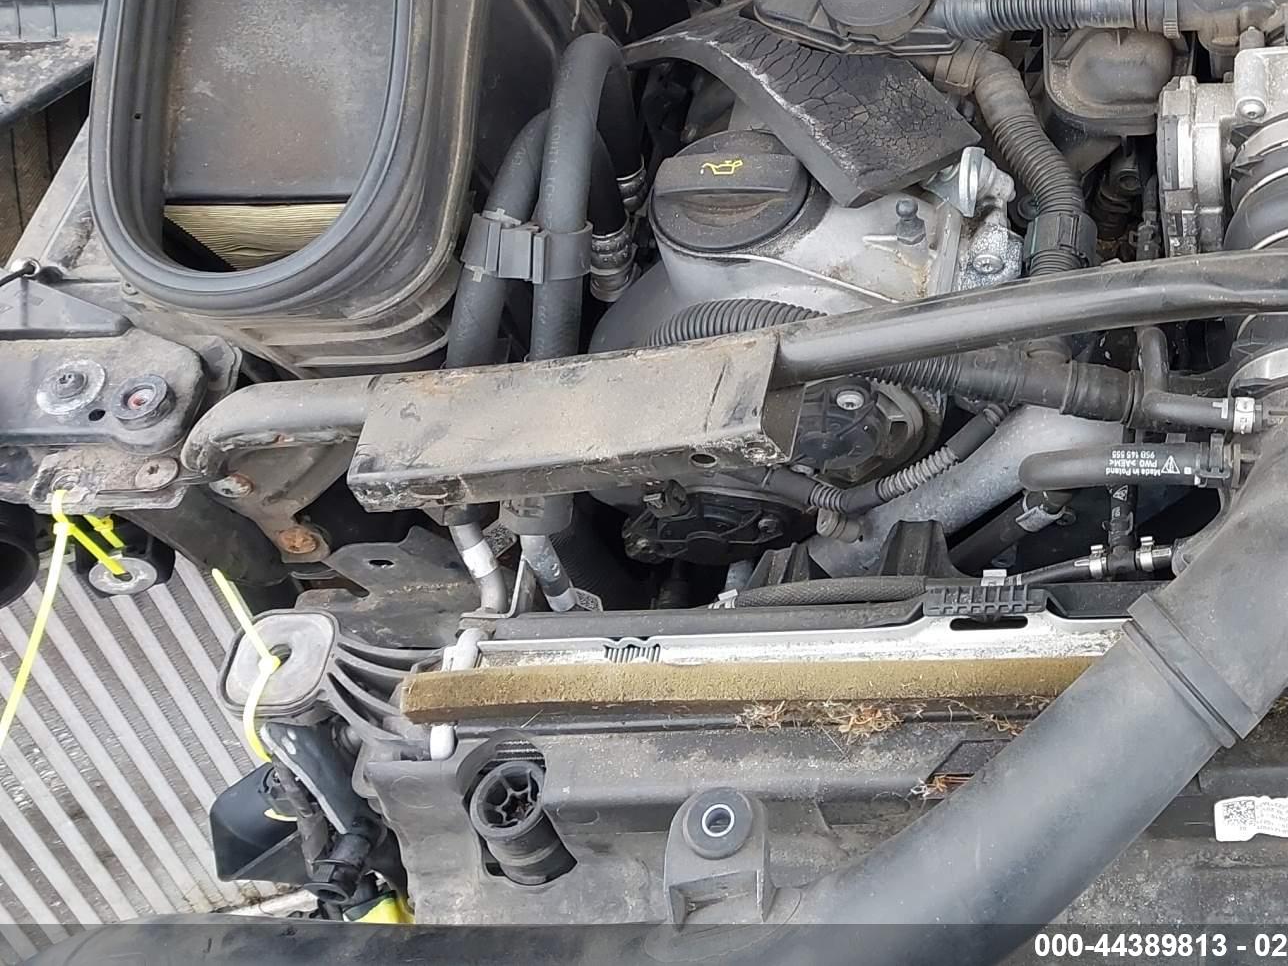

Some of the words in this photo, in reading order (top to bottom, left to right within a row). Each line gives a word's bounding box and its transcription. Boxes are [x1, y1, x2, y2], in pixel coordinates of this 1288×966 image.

[1112, 450, 1125, 459] 555
[1105, 467, 1132, 476] Poland
[1132, 467, 1140, 476] in
[1141, 467, 1161, 476] Made
